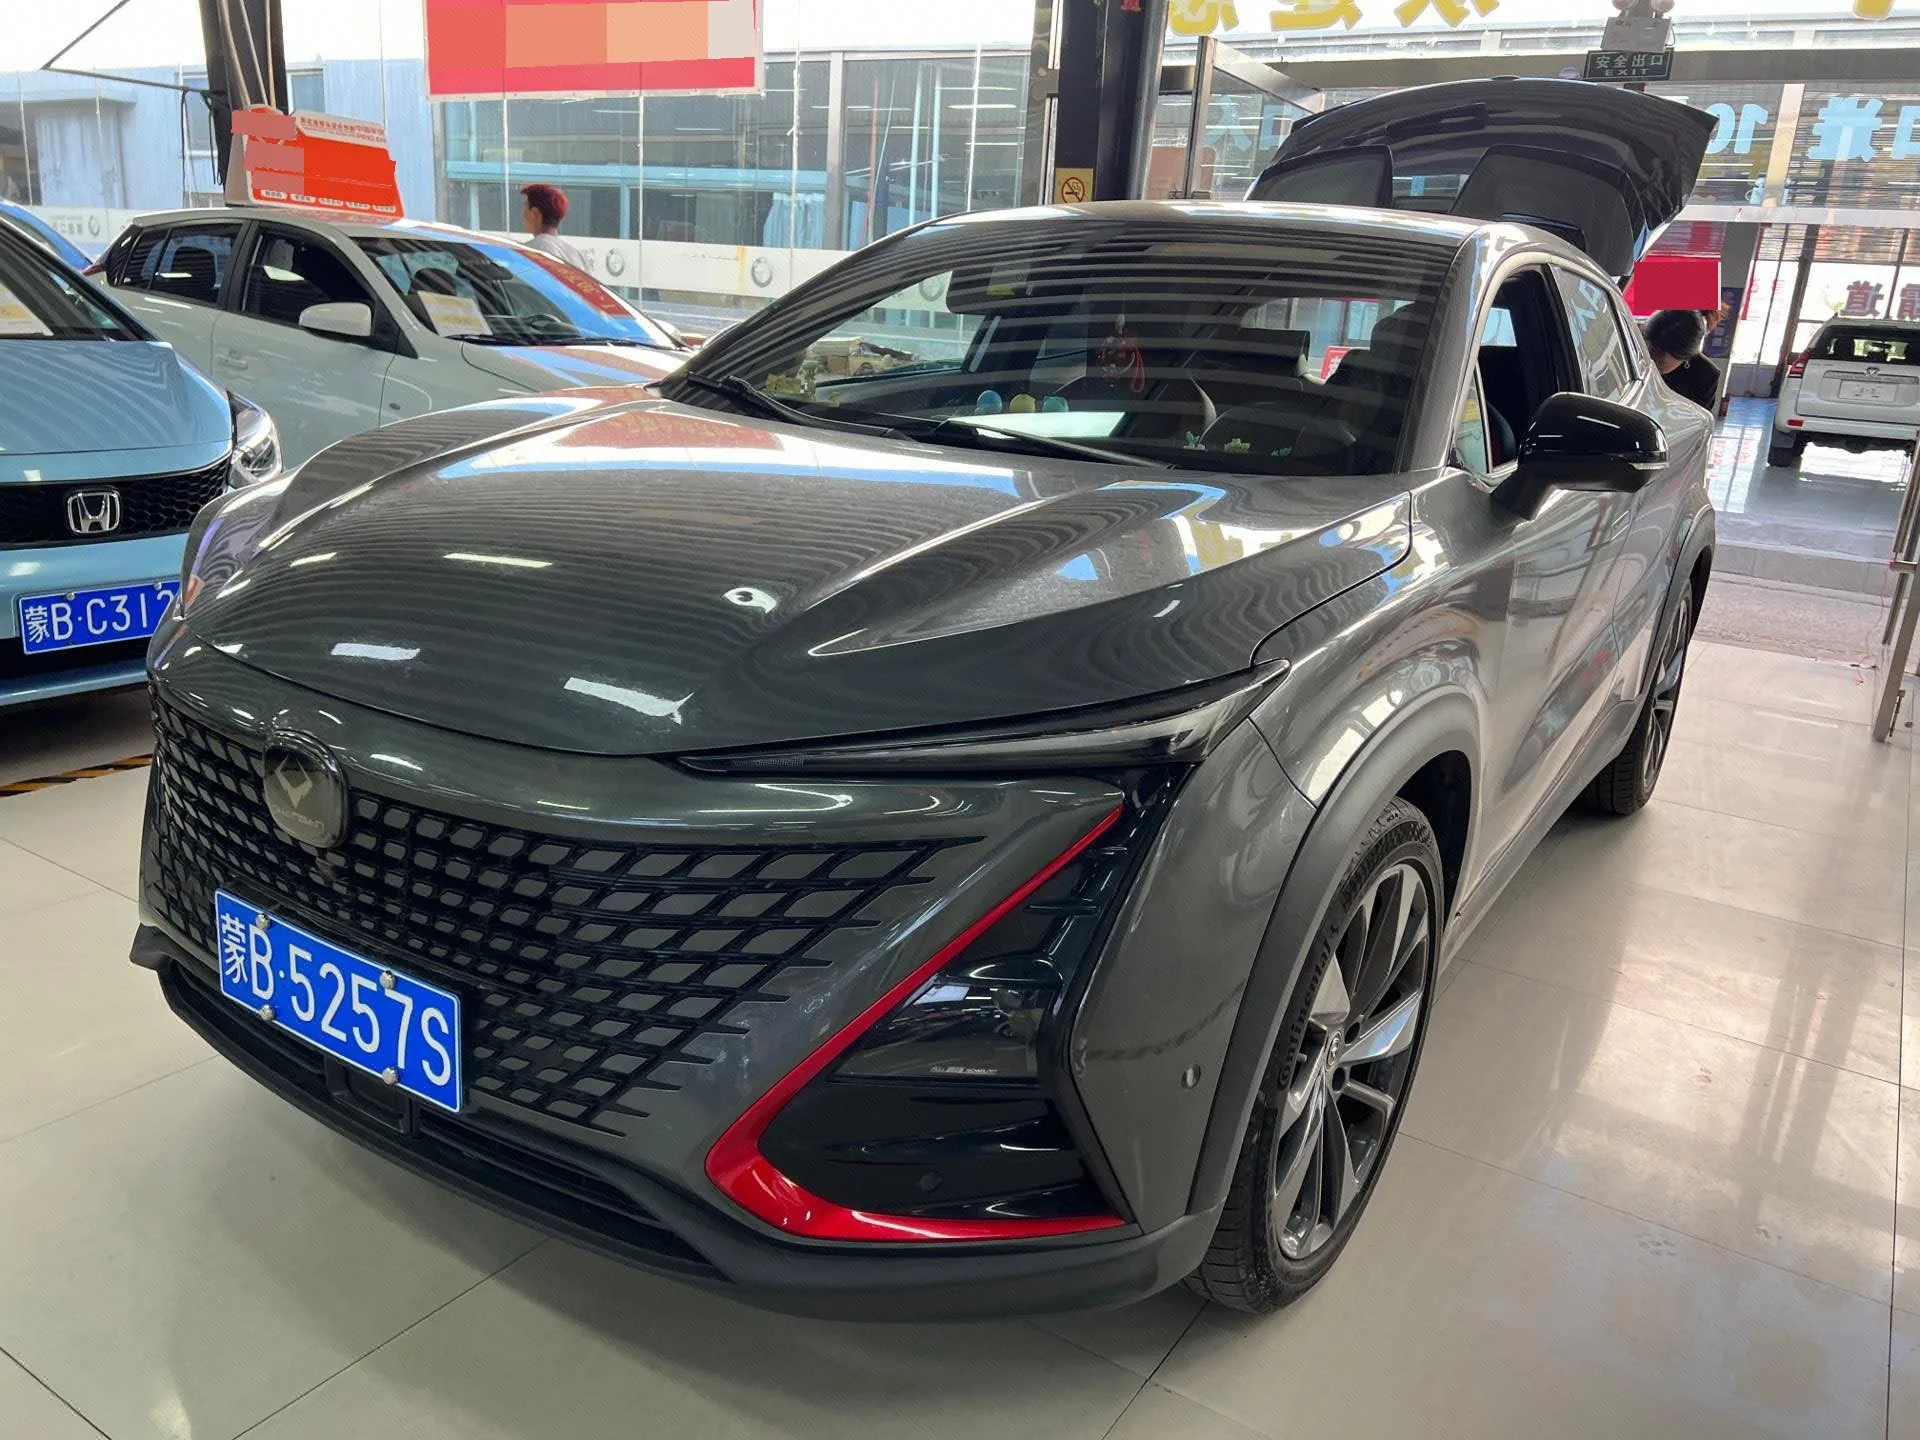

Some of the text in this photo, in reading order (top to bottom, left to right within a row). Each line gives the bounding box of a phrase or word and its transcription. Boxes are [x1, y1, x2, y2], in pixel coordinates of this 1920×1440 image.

[1595, 54, 1664, 69] 安全出口
[1605, 68, 1650, 77] EXIT
[220, 912, 451, 1087] 蒙B·5257S
